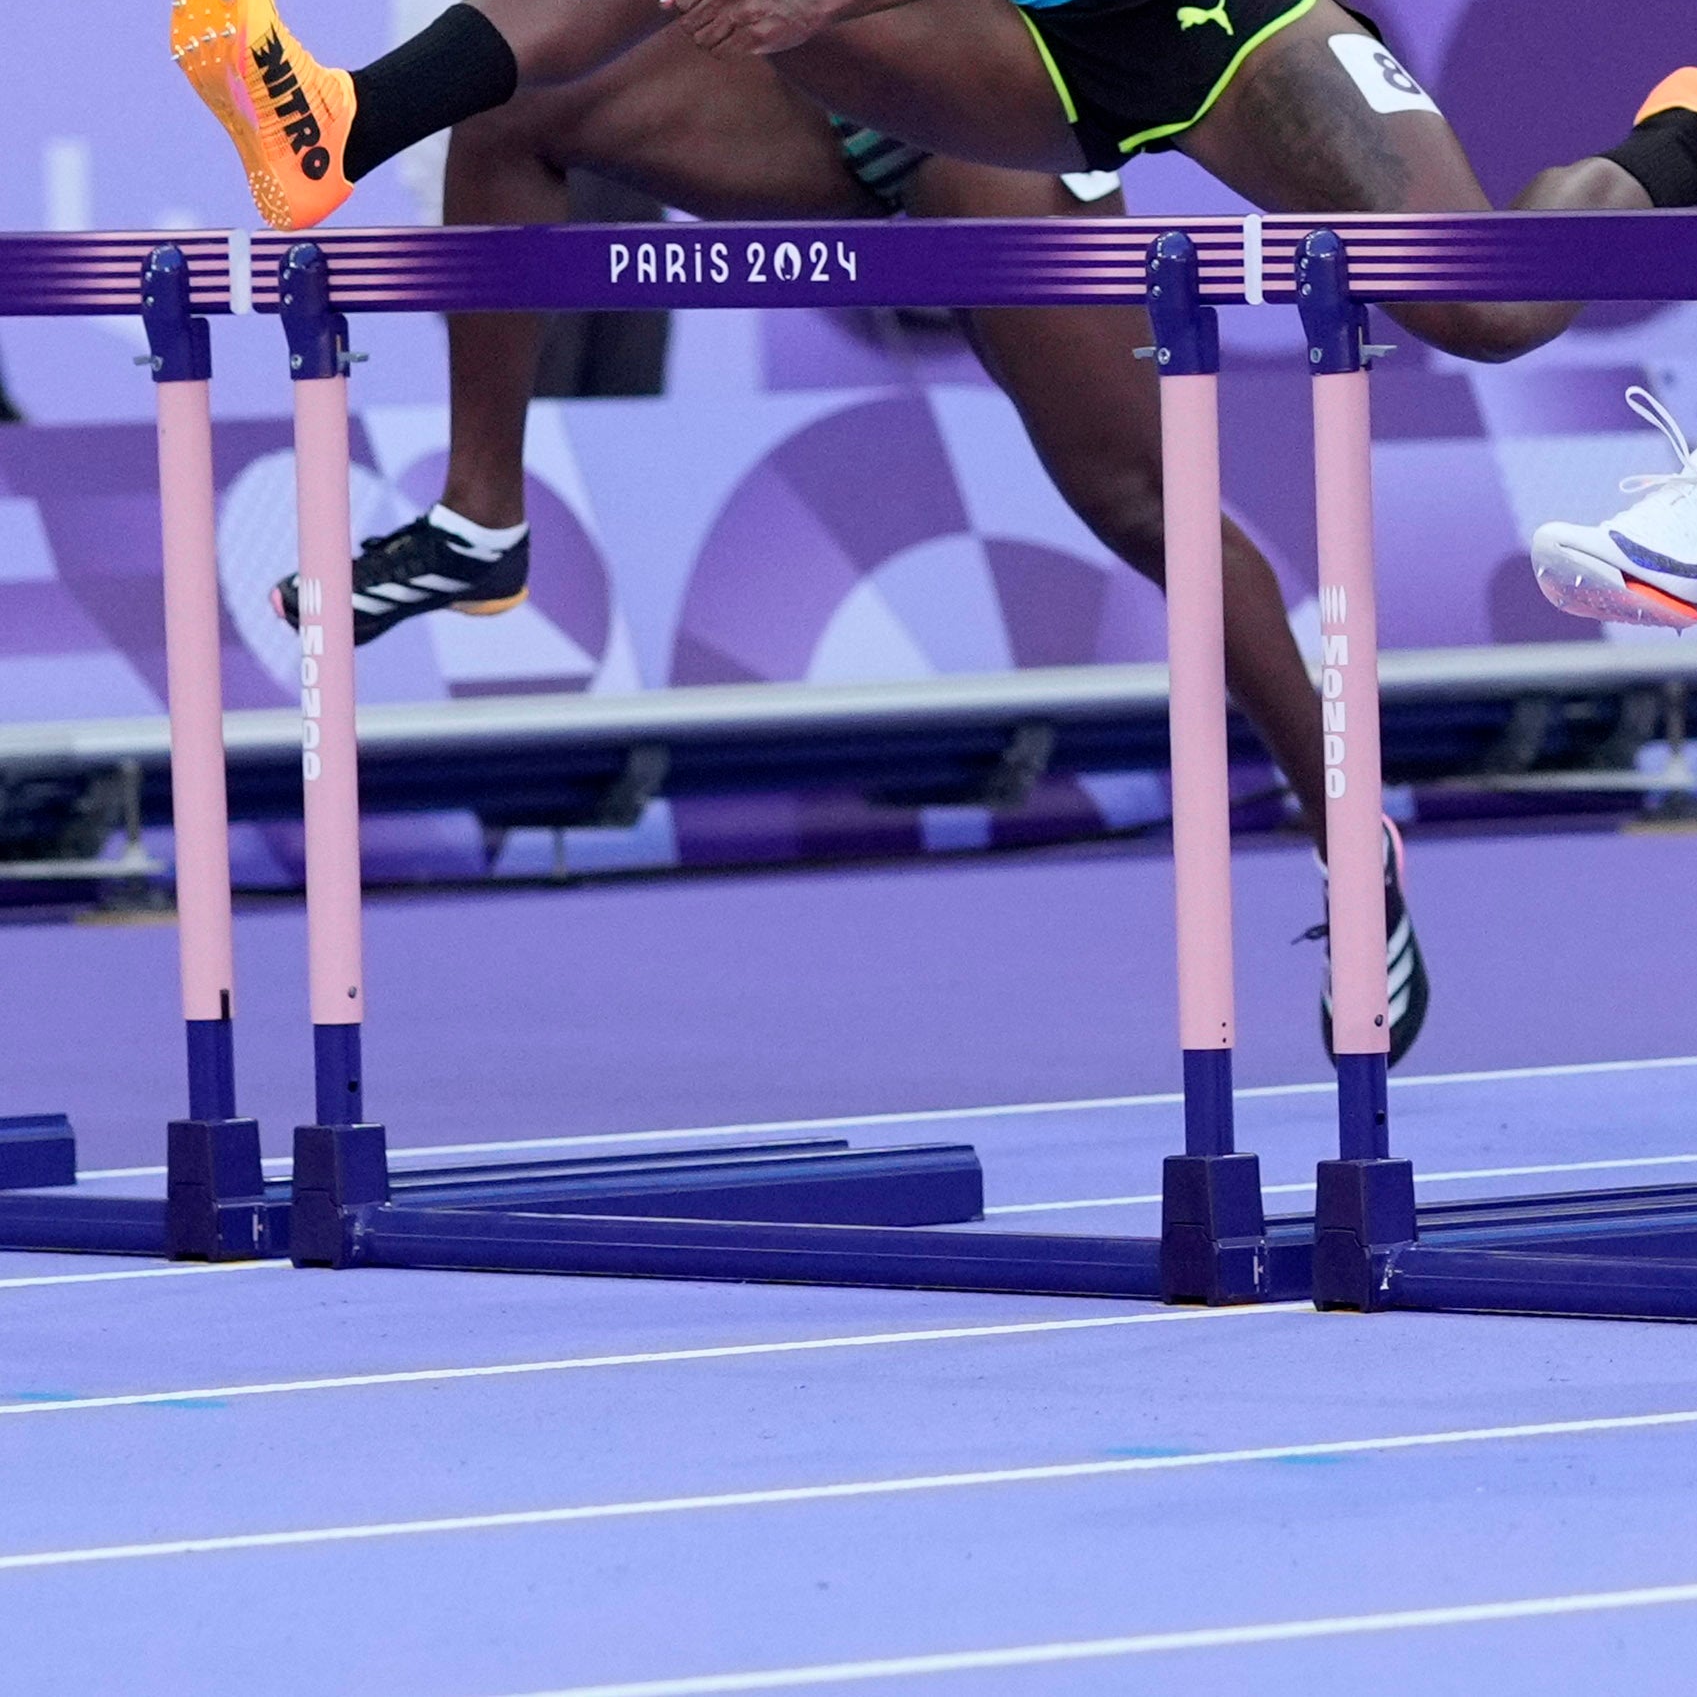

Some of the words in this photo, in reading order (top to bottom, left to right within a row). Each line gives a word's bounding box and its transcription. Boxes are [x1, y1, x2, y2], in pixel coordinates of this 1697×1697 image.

[250, 21, 331, 181] NITRO
[1373, 52, 1422, 95] 8
[746, 241, 857, 282] 2024
[301, 624, 324, 782] MONDO
[1322, 635, 1349, 799] MONDO
